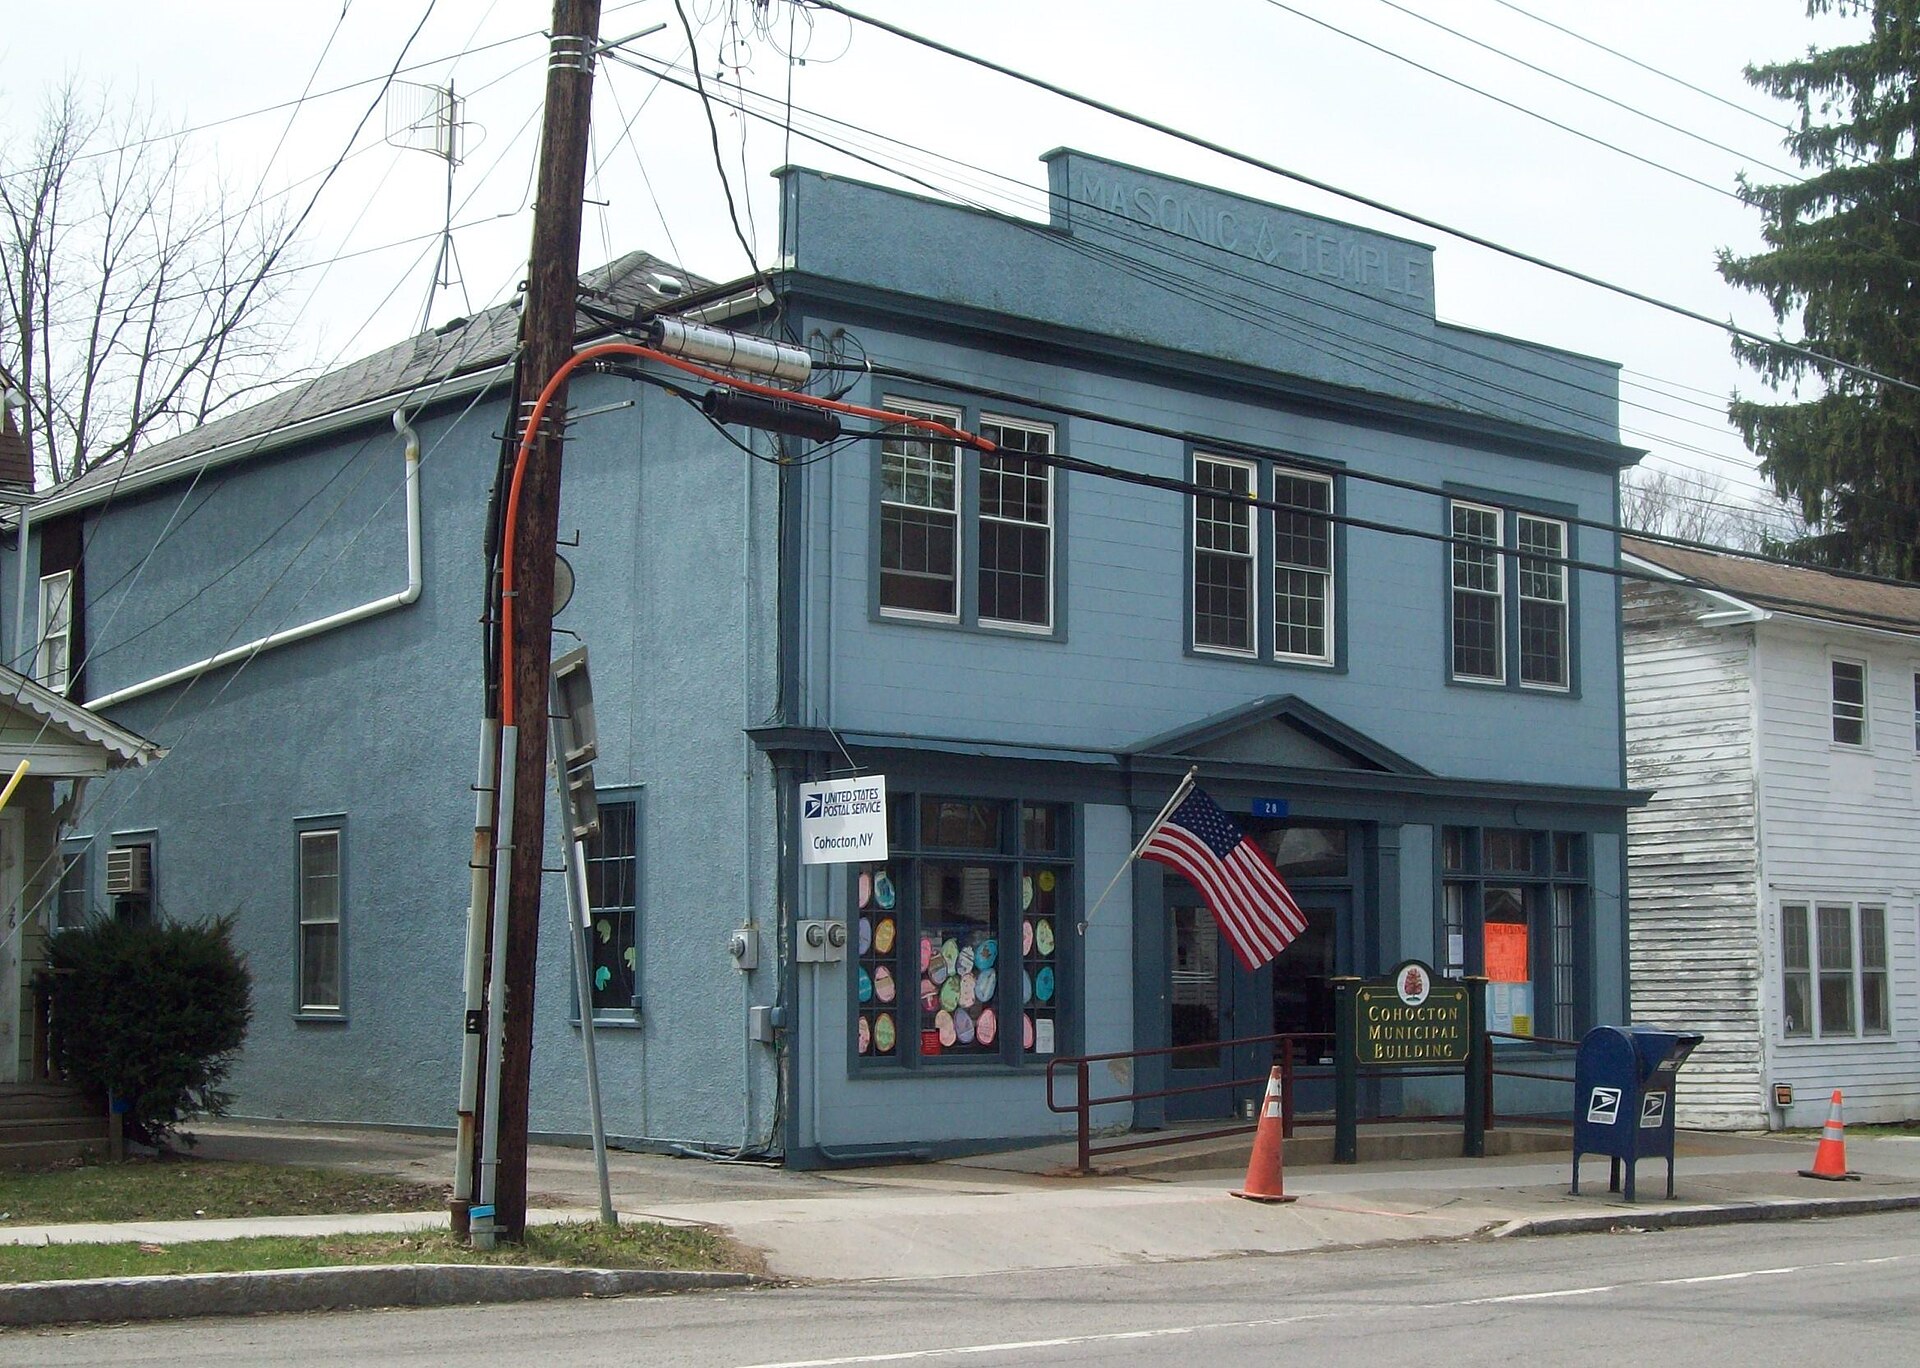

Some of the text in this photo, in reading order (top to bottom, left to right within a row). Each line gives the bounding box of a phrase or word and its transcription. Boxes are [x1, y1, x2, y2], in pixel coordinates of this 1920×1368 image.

[1294, 230, 1430, 300] TEMPLE
[825, 788, 878, 803] UNITED STATES
[823, 801, 881, 817] POSTAL SERVICE
[1265, 803, 1277, 813] 28
[1368, 1006, 1459, 1022] COHOCTON
[1368, 1025, 1459, 1040] MUNICIPAL
[1374, 1044, 1454, 1059] BUILDING
